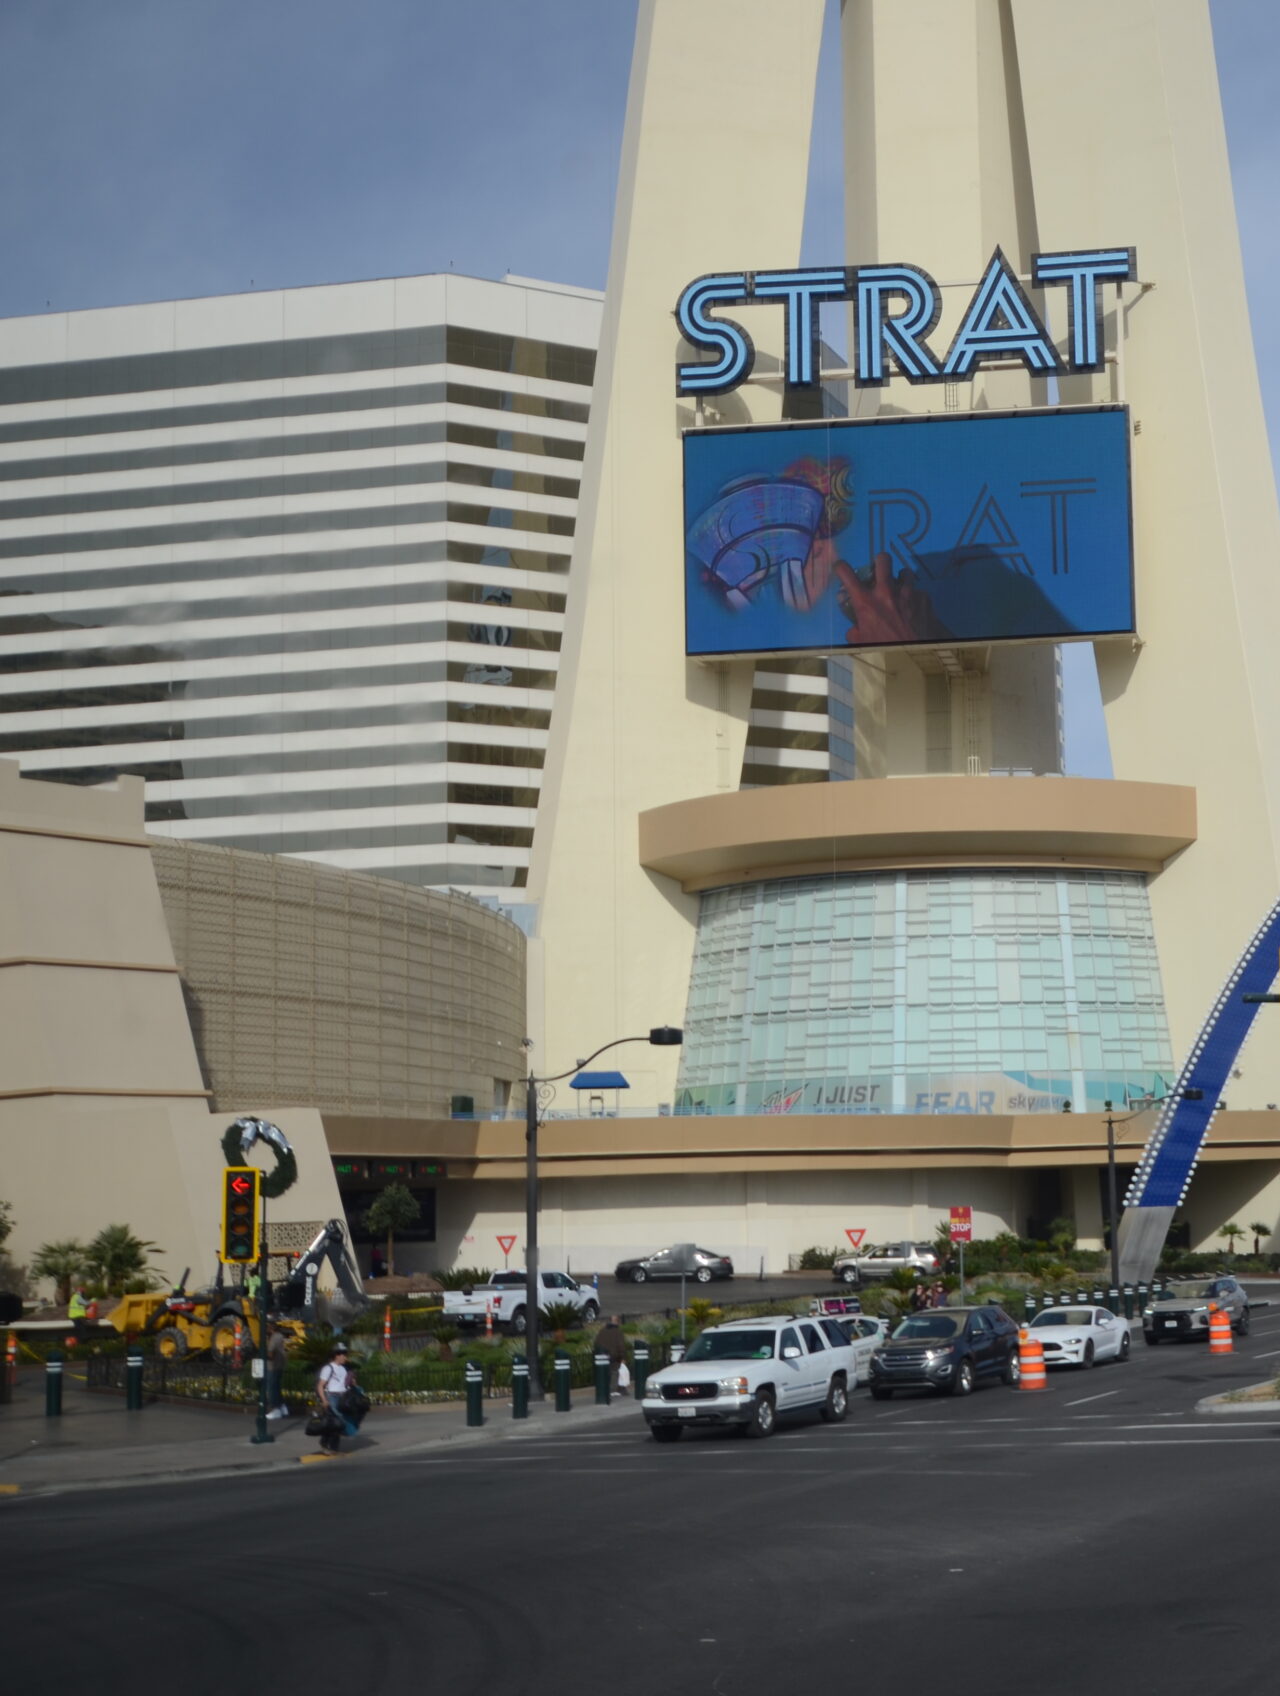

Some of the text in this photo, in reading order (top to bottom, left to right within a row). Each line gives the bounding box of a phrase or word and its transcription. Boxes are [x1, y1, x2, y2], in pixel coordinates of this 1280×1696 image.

[676, 246, 1136, 398] STRAT
[815, 1087, 823, 1105] I
[825, 1084, 881, 1104] JUST
[915, 1090, 997, 1114] FEAR
[950, 1223, 971, 1232] STOP
